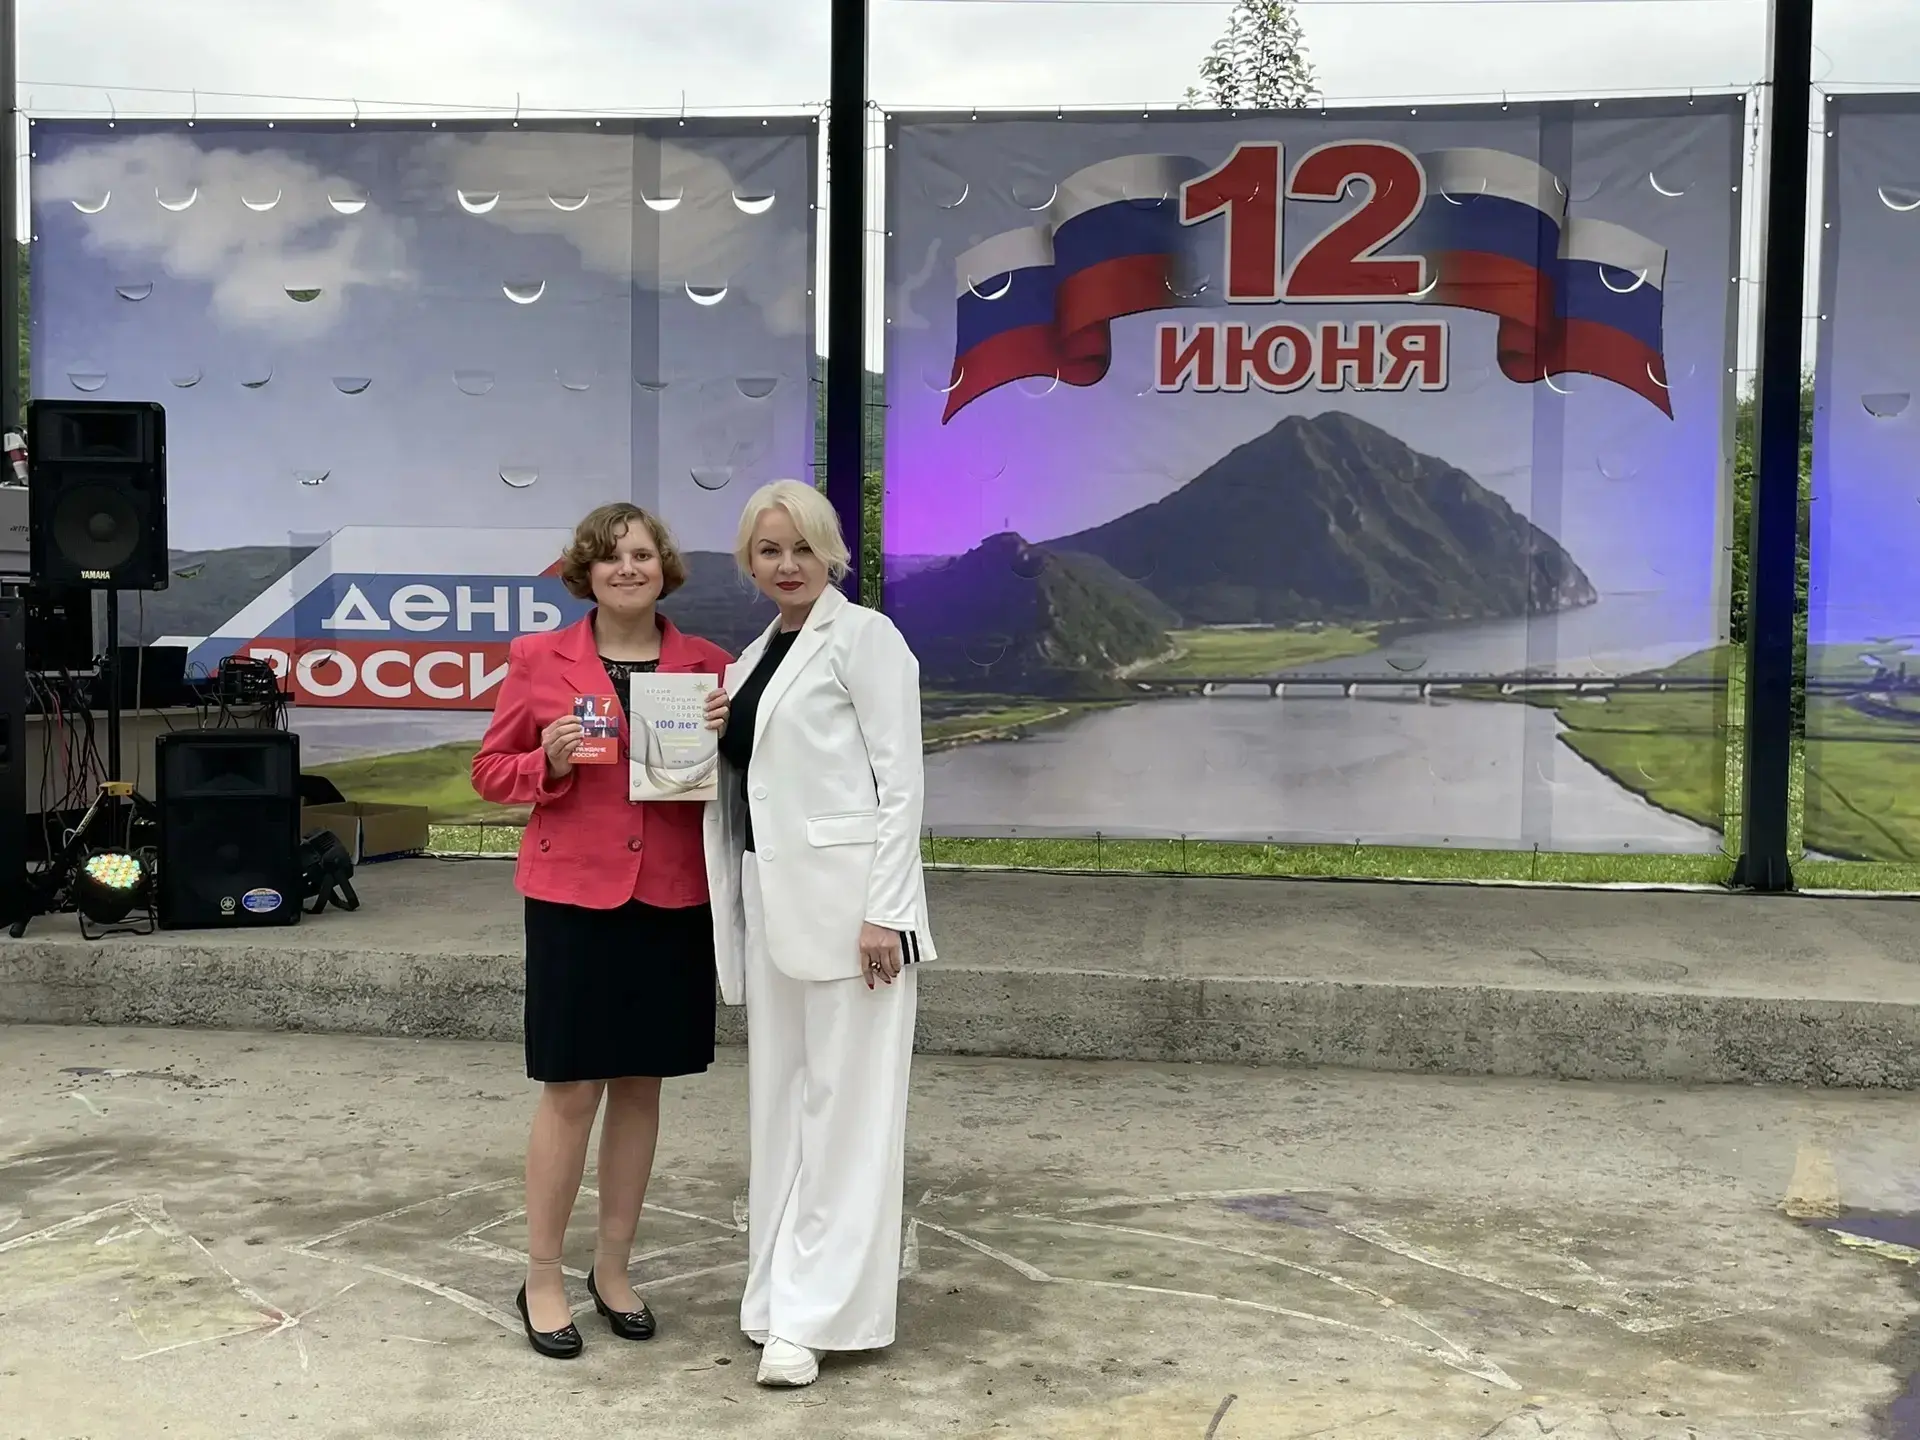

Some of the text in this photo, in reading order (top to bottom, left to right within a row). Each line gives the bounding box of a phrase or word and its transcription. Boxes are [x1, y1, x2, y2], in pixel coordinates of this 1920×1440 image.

[1180, 139, 1426, 304] 12
[1155, 320, 1449, 392] ИЮНЯ
[81, 570, 111, 580] YAMAHA
[249, 647, 511, 701] РОССИ
[655, 720, 699, 730] 100 лет
